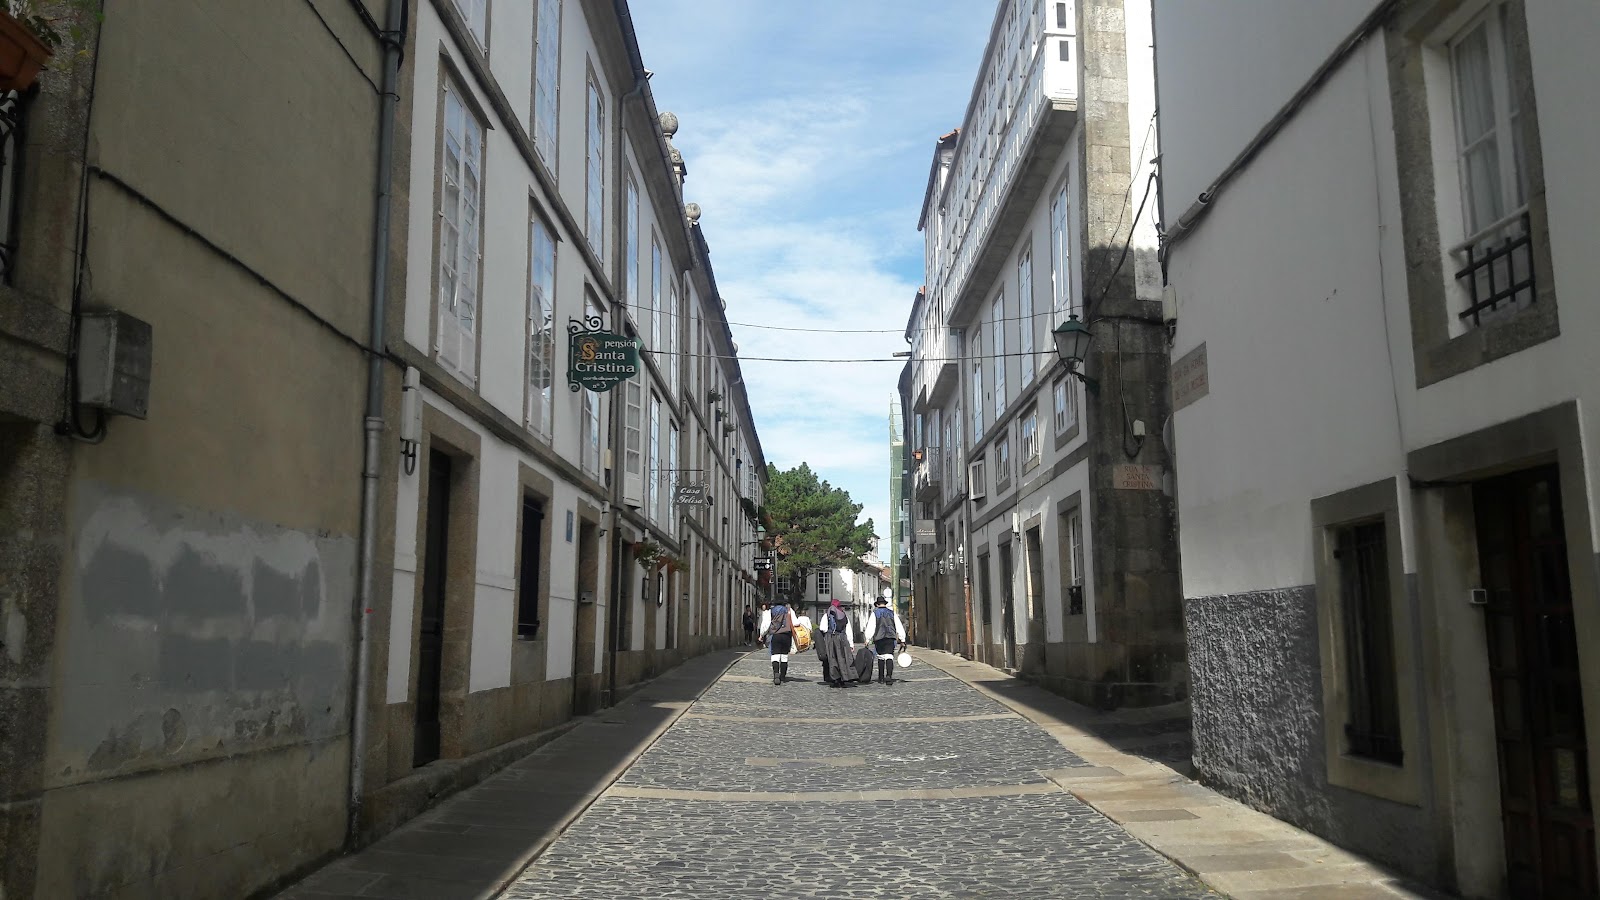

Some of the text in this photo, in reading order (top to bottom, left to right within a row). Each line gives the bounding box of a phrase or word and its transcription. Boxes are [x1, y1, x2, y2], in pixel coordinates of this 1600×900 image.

[604, 340, 637, 349] pensión
[582, 342, 625, 360] Santa
[575, 362, 635, 372] Cristina
